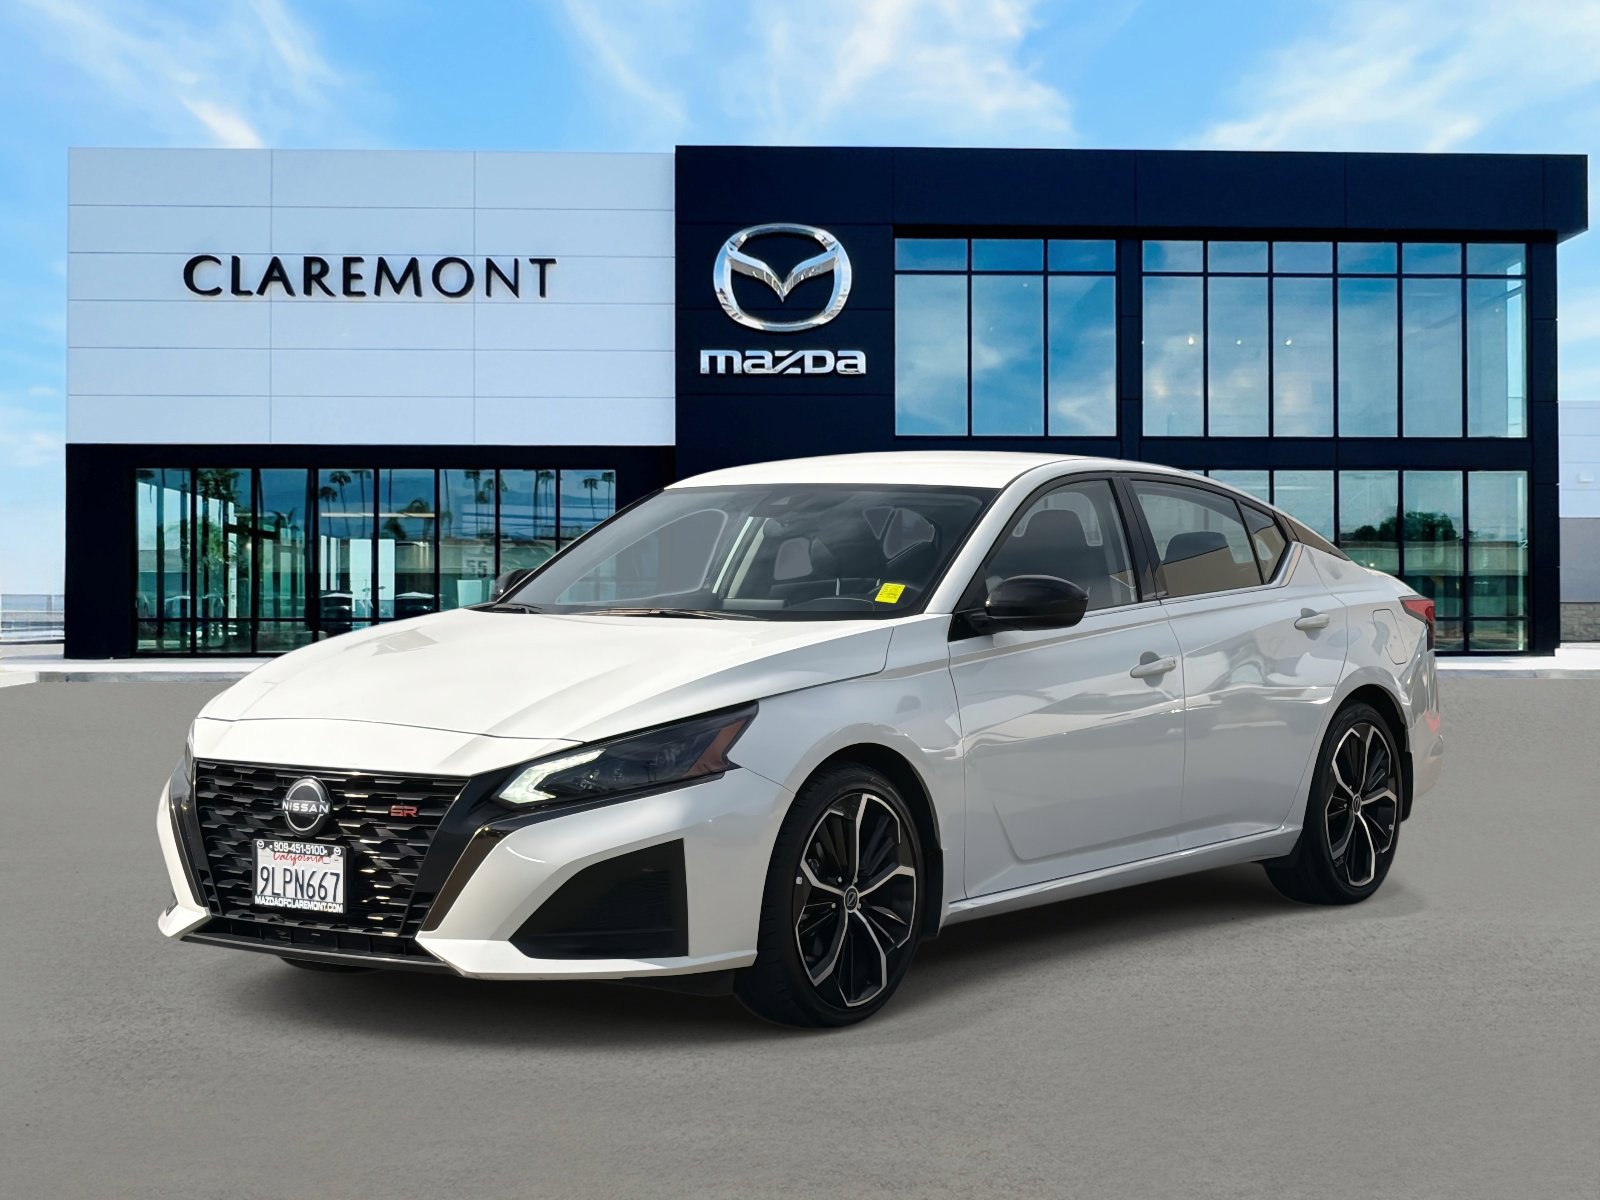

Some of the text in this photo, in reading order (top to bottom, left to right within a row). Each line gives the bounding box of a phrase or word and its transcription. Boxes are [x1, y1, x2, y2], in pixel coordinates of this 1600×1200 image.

[183, 254, 557, 298] CLAREMONT
[700, 350, 867, 375] mazda
[282, 801, 329, 813] NISSAN
[390, 805, 417, 817] SR
[272, 852, 324, 866] California
[260, 866, 340, 902] 9LPN667
